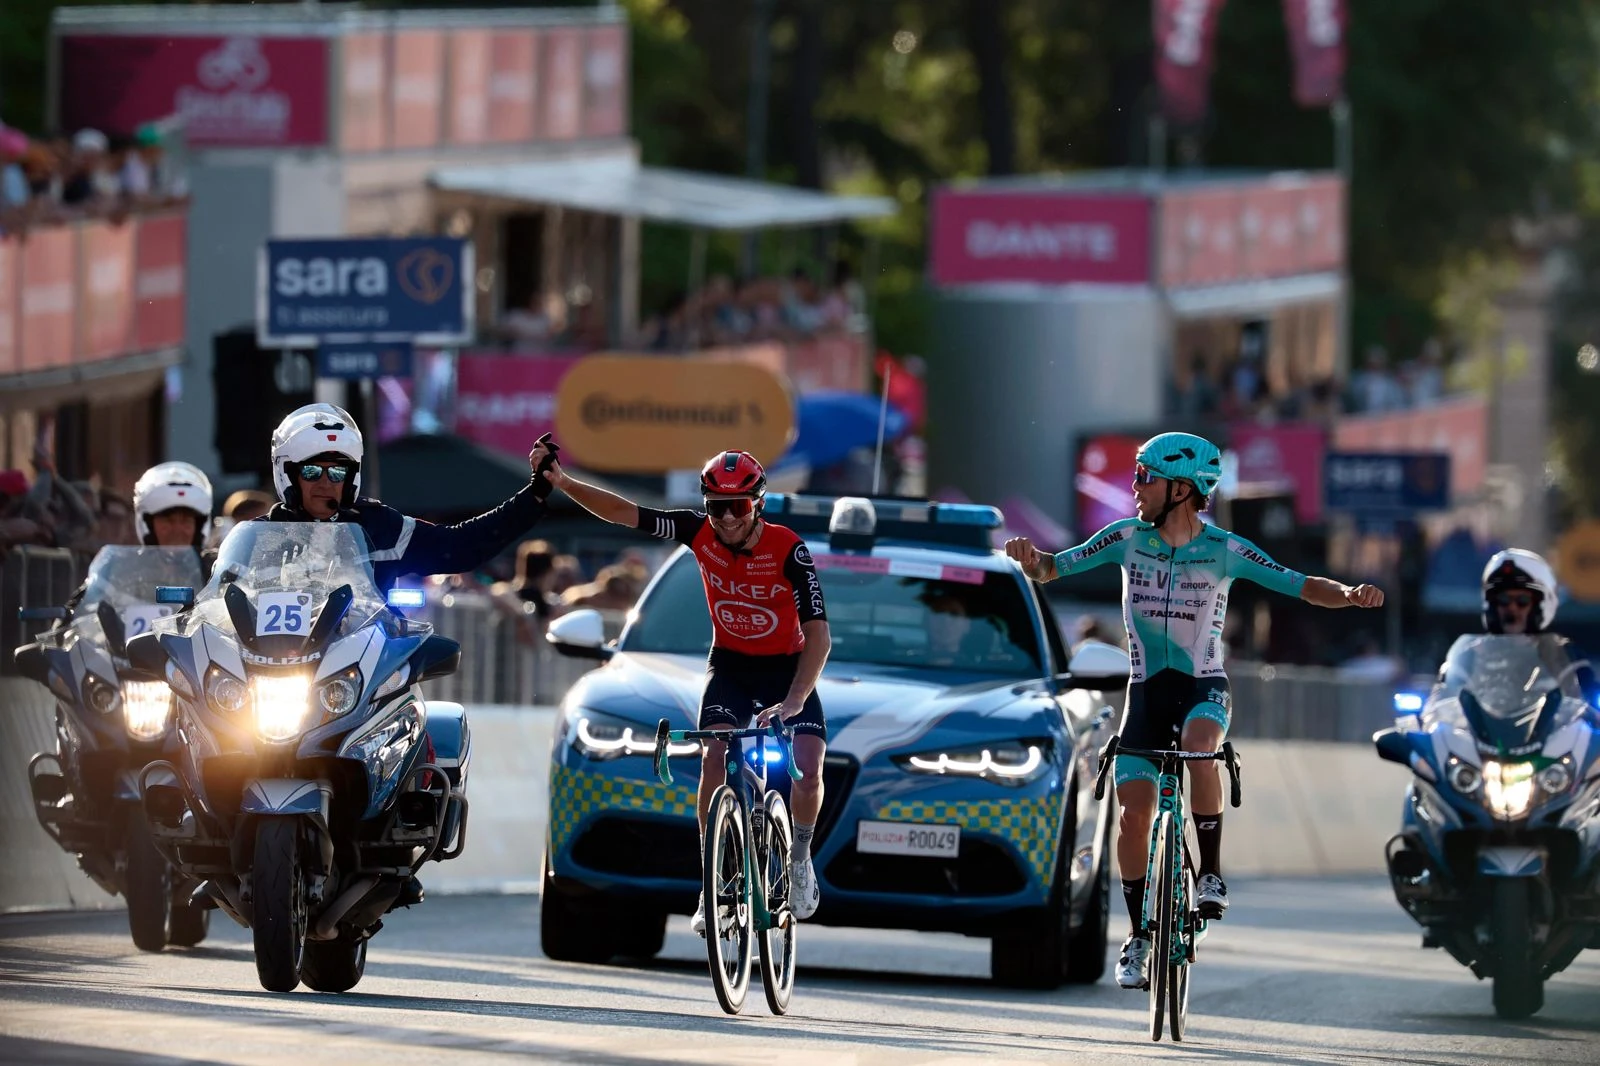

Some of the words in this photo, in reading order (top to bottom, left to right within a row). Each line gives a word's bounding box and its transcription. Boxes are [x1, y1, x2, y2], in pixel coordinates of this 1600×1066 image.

[965, 219, 1117, 261] DANTE
[276, 257, 388, 297] sara
[699, 561, 788, 599] ARKEA
[806, 570, 824, 616] ARKEA
[720, 608, 769, 626] B&B
[1184, 599, 1208, 608] CSF
[264, 604, 302, 632] 25
[242, 650, 321, 665] POLIZIA
[908, 829, 956, 850] R0049
